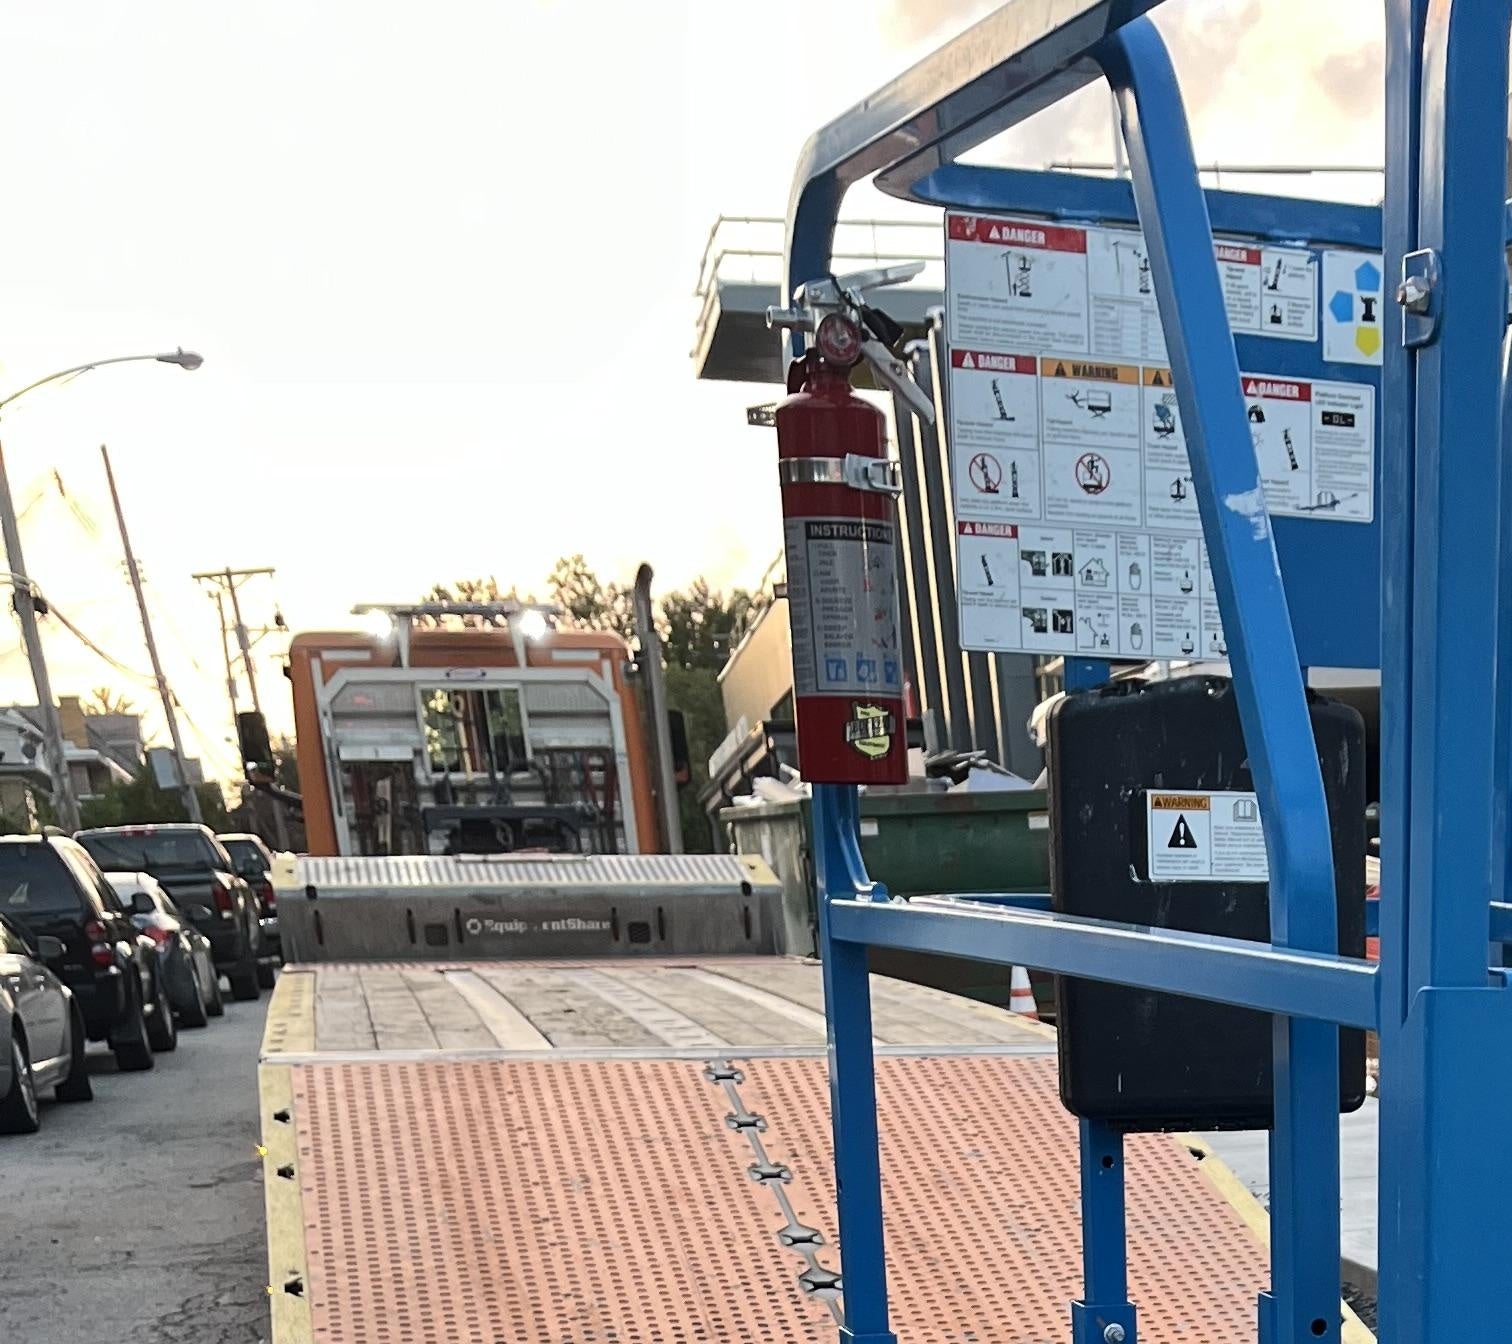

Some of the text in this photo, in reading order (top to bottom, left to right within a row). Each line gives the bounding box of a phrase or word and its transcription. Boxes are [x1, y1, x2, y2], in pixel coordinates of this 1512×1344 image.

[1001, 226, 1046, 245] DANGER
[977, 355, 1016, 371] DANGER
[1072, 363, 1118, 380] WARNING
[1258, 382, 1299, 398] DANGER
[973, 524, 1012, 537] DANGER
[1163, 796, 1207, 809] WARNING
